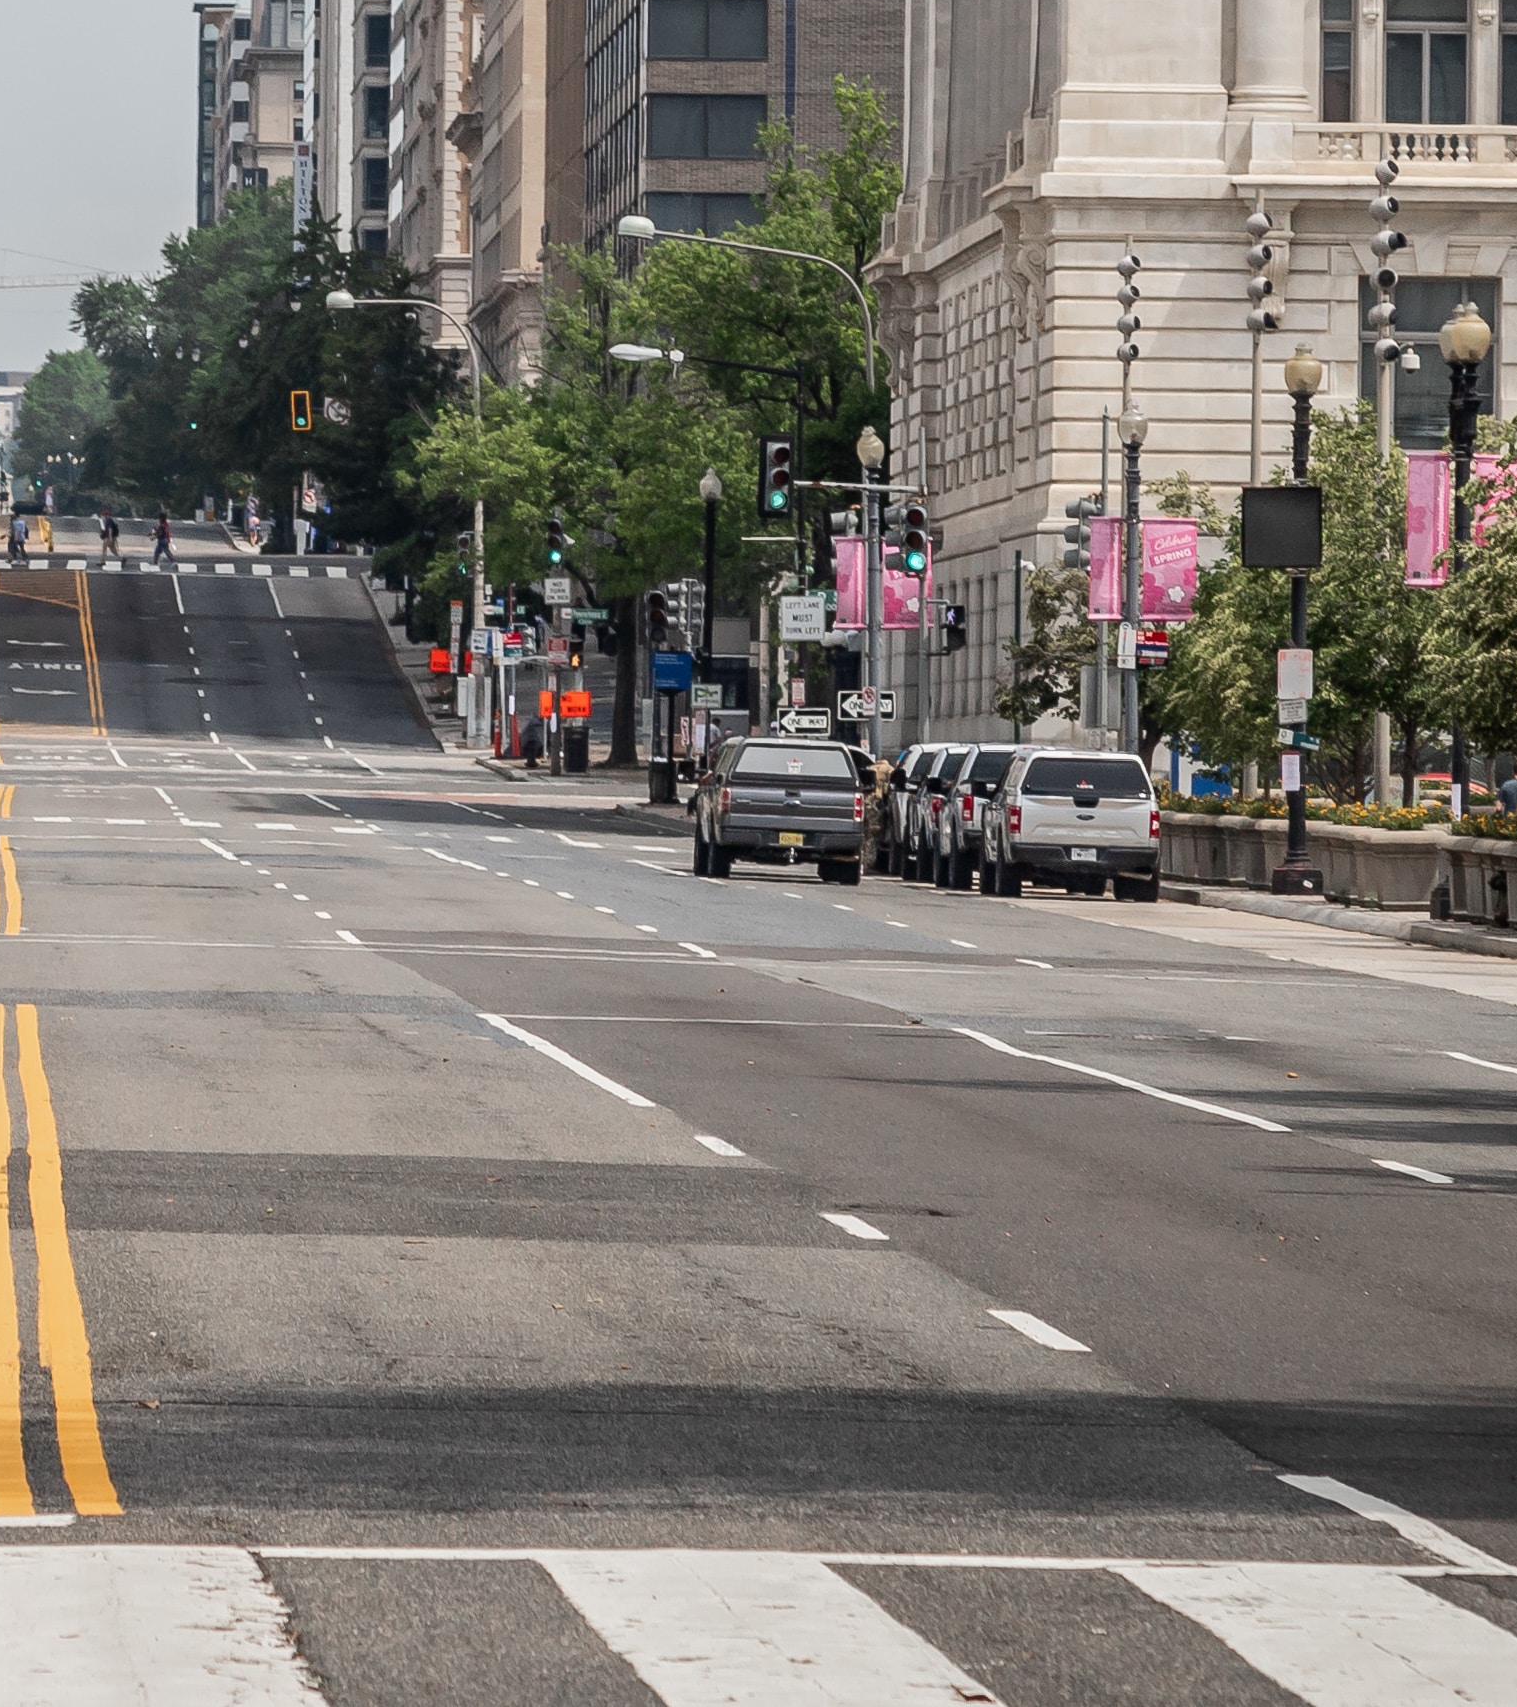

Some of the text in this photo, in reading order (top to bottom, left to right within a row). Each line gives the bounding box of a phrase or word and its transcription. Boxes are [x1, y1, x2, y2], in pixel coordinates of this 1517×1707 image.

[1154, 532, 1193, 552] Celebrate
[1153, 546, 1193, 566] SPRING
[785, 602, 802, 610] LEFT
[804, 601, 820, 609] LANE
[792, 614, 813, 623] MUST
[785, 627, 802, 635] TURN
[787, 717, 826, 726] ONE WAY
